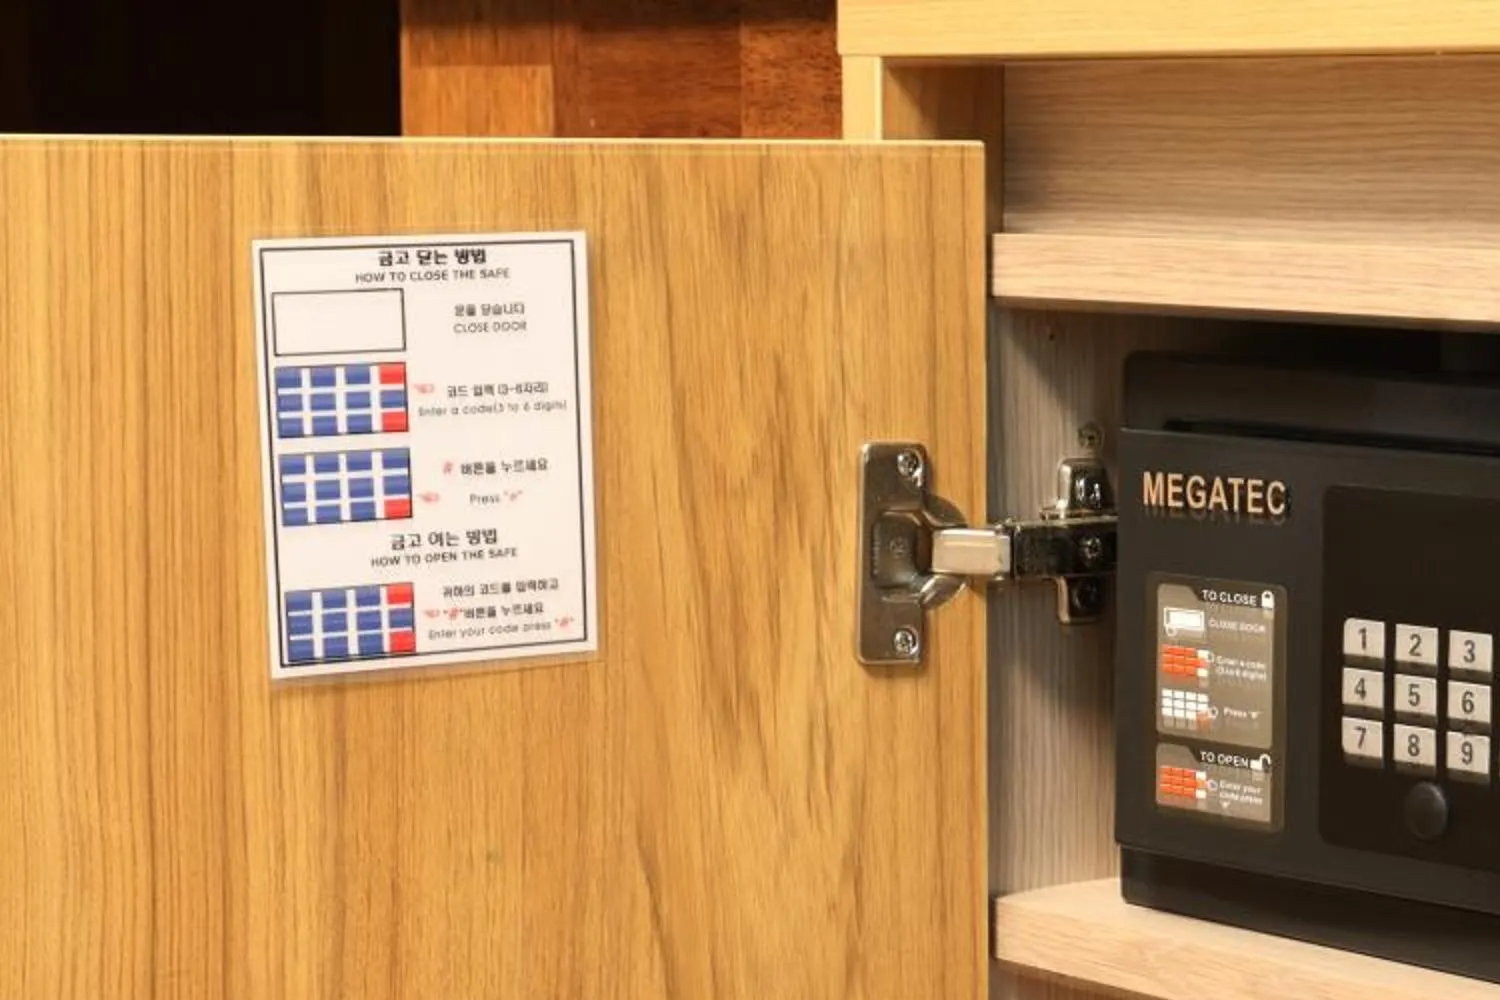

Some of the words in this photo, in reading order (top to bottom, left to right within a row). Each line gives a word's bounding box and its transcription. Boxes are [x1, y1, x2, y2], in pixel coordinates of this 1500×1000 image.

[378, 250, 409, 266] 금고
[416, 249, 448, 265] 닫는
[355, 271, 385, 283] HOW
[389, 271, 407, 282] TO
[410, 270, 448, 281] CLOSE
[453, 269, 475, 280] THE
[480, 268, 510, 279] SAFE
[453, 322, 489, 333] CLOSE
[492, 321, 527, 332] DOOR
[418, 405, 447, 417] Enter
[469, 493, 500, 505] Press
[1143, 471, 1286, 515] MEGATEC
[391, 533, 421, 551] 금고
[428, 531, 459, 547] 여는
[371, 556, 400, 568] HOW
[405, 555, 421, 566] TO
[425, 552, 457, 564] OPEN
[462, 549, 484, 560] THE
[488, 547, 517, 559] SAFE
[1201, 589, 1217, 601] TO
[1219, 591, 1257, 606] CLOSE
[428, 628, 456, 641] Enter
[461, 625, 485, 639] your
[489, 623, 519, 635] code
[523, 621, 551, 634] press
[1358, 627, 1367, 650] 1
[1409, 633, 1422, 657] 2
[1463, 639, 1476, 663] 3
[1354, 677, 1367, 700] 4
[1408, 684, 1421, 707] 5
[1461, 691, 1474, 714] 6
[1355, 726, 1367, 749] 7
[1408, 734, 1421, 757] 8
[1461, 742, 1473, 765] 9
[1200, 751, 1215, 762] TO
[1217, 753, 1249, 768] OPEN
